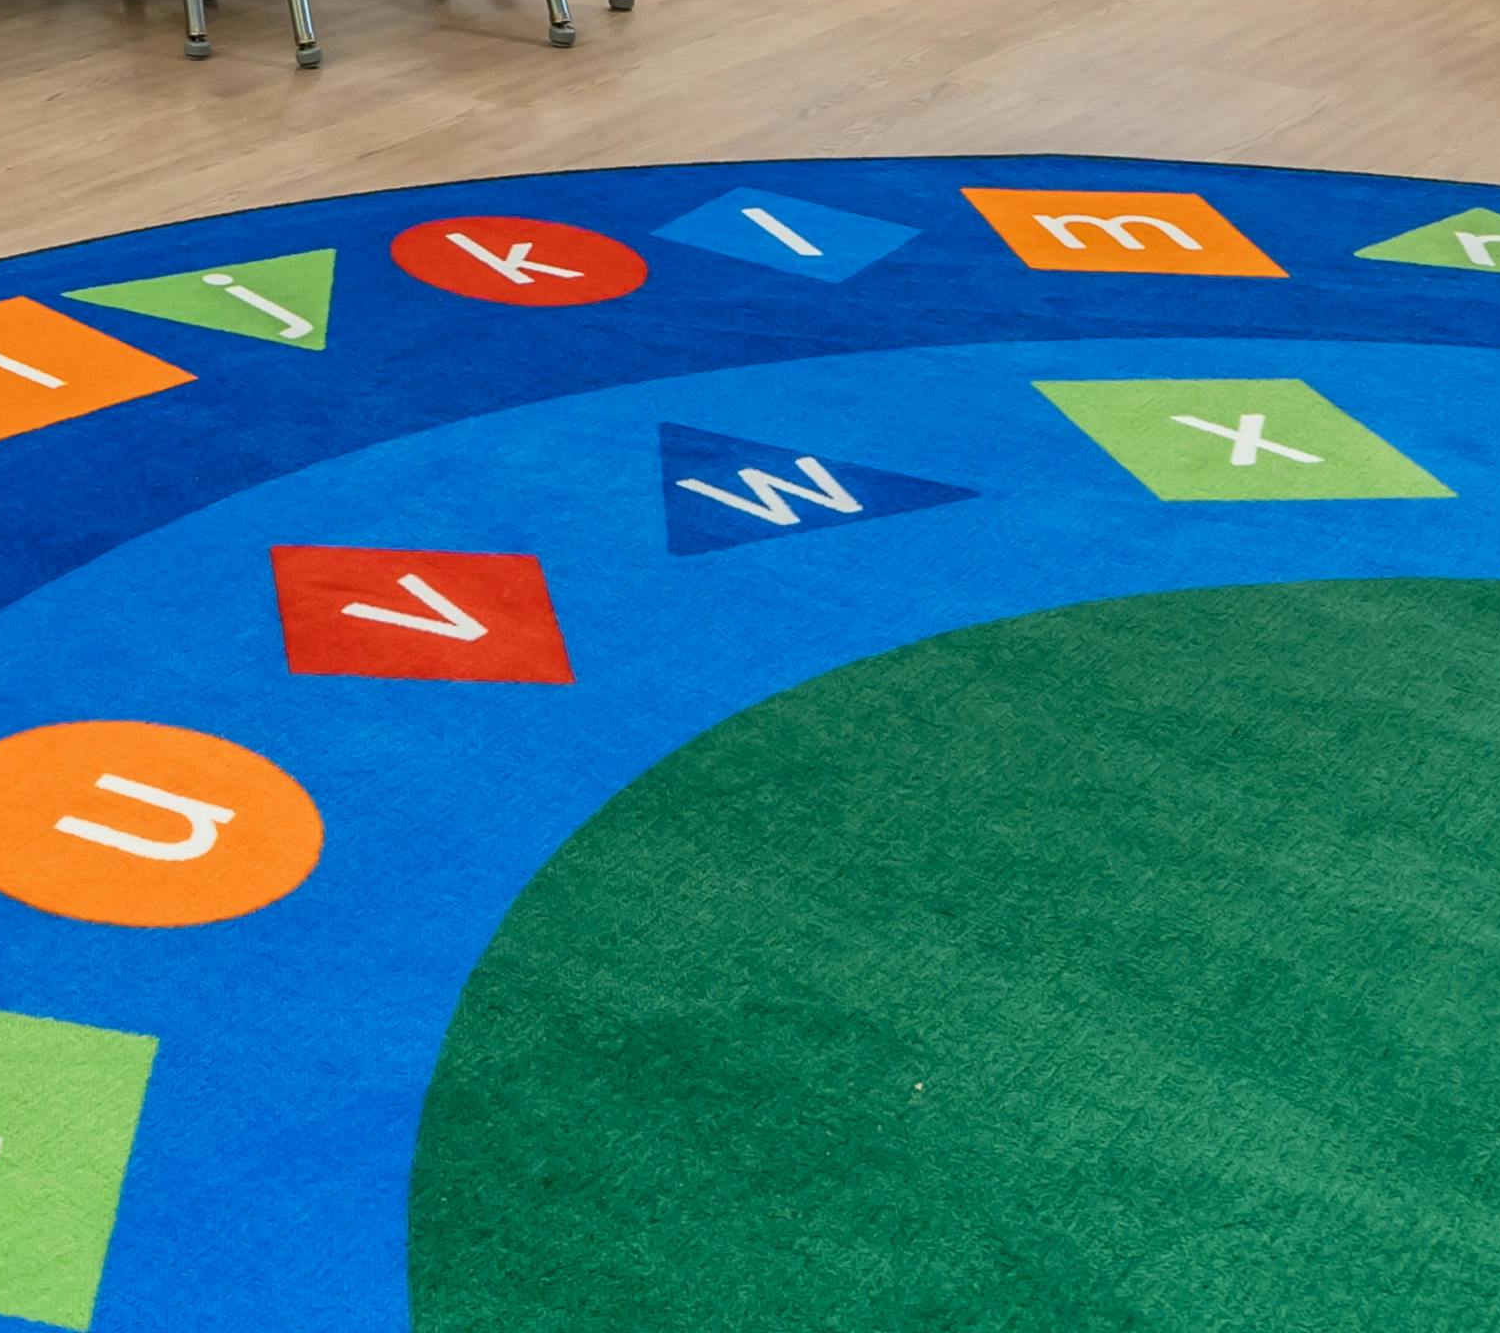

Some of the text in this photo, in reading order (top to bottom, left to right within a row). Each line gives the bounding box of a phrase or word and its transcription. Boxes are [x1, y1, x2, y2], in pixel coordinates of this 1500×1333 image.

[201, 272, 315, 341] j
[445, 232, 584, 285] k
[741, 207, 823, 257] l
[1034, 214, 1203, 251] m
[54, 773, 236, 862] u
[341, 573, 489, 642] v
[676, 456, 863, 526] w
[1168, 412, 1326, 468] x
